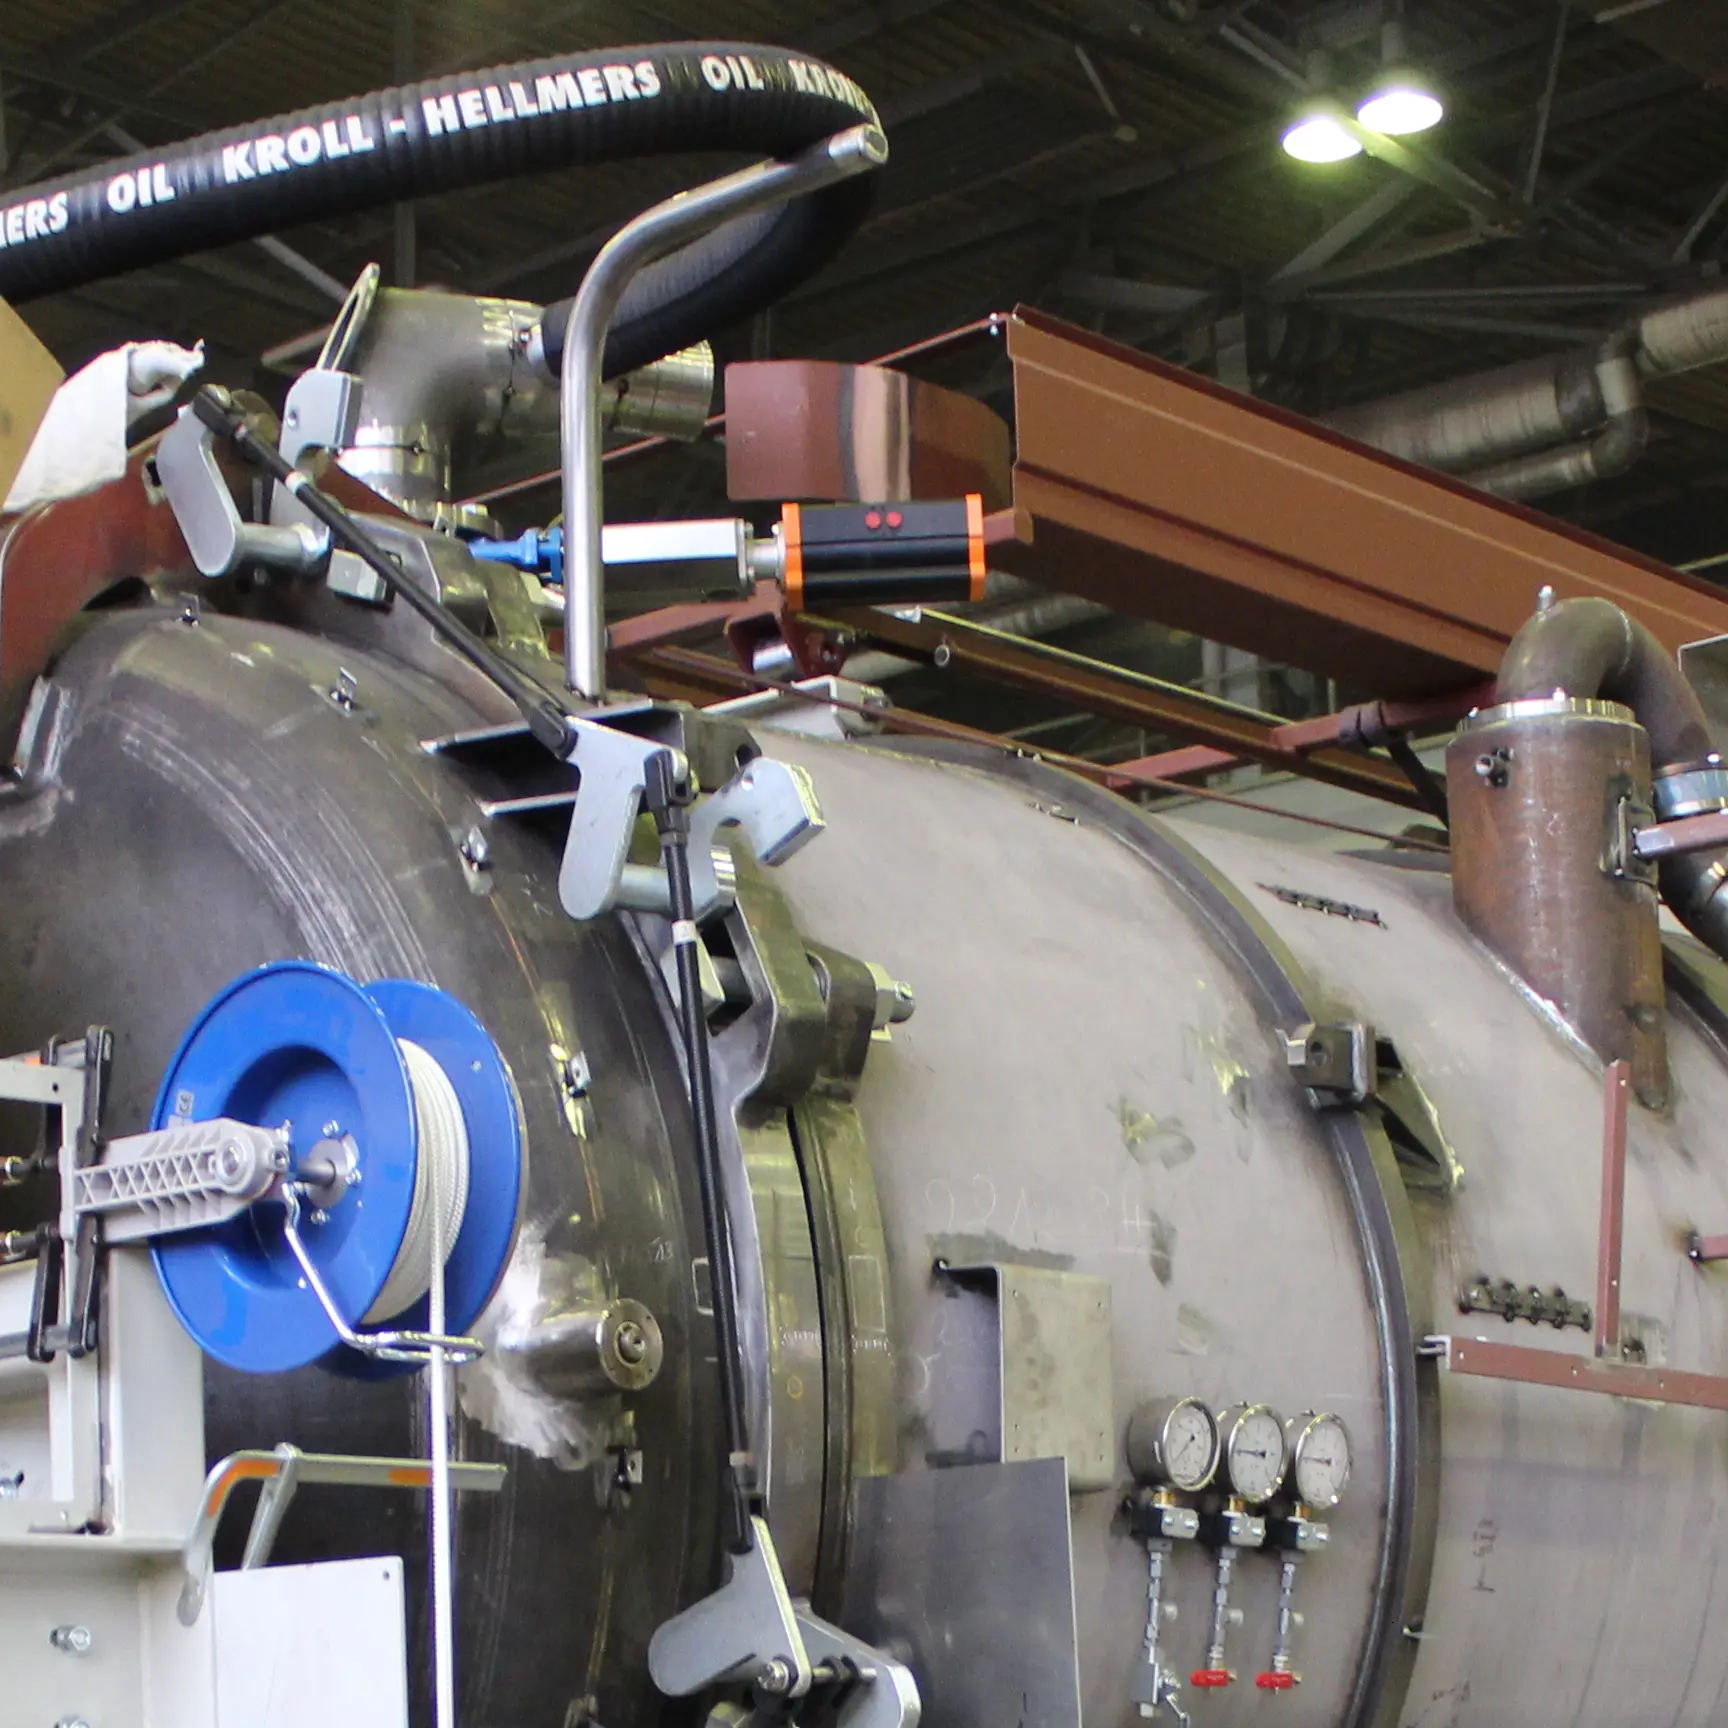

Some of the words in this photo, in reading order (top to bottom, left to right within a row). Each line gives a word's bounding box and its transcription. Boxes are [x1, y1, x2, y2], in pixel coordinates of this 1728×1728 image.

[107, 162, 175, 214] OIL
[221, 114, 374, 184] KROLL
[421, 60, 661, 138] HELLMERS
[700, 55, 765, 91] OIL
